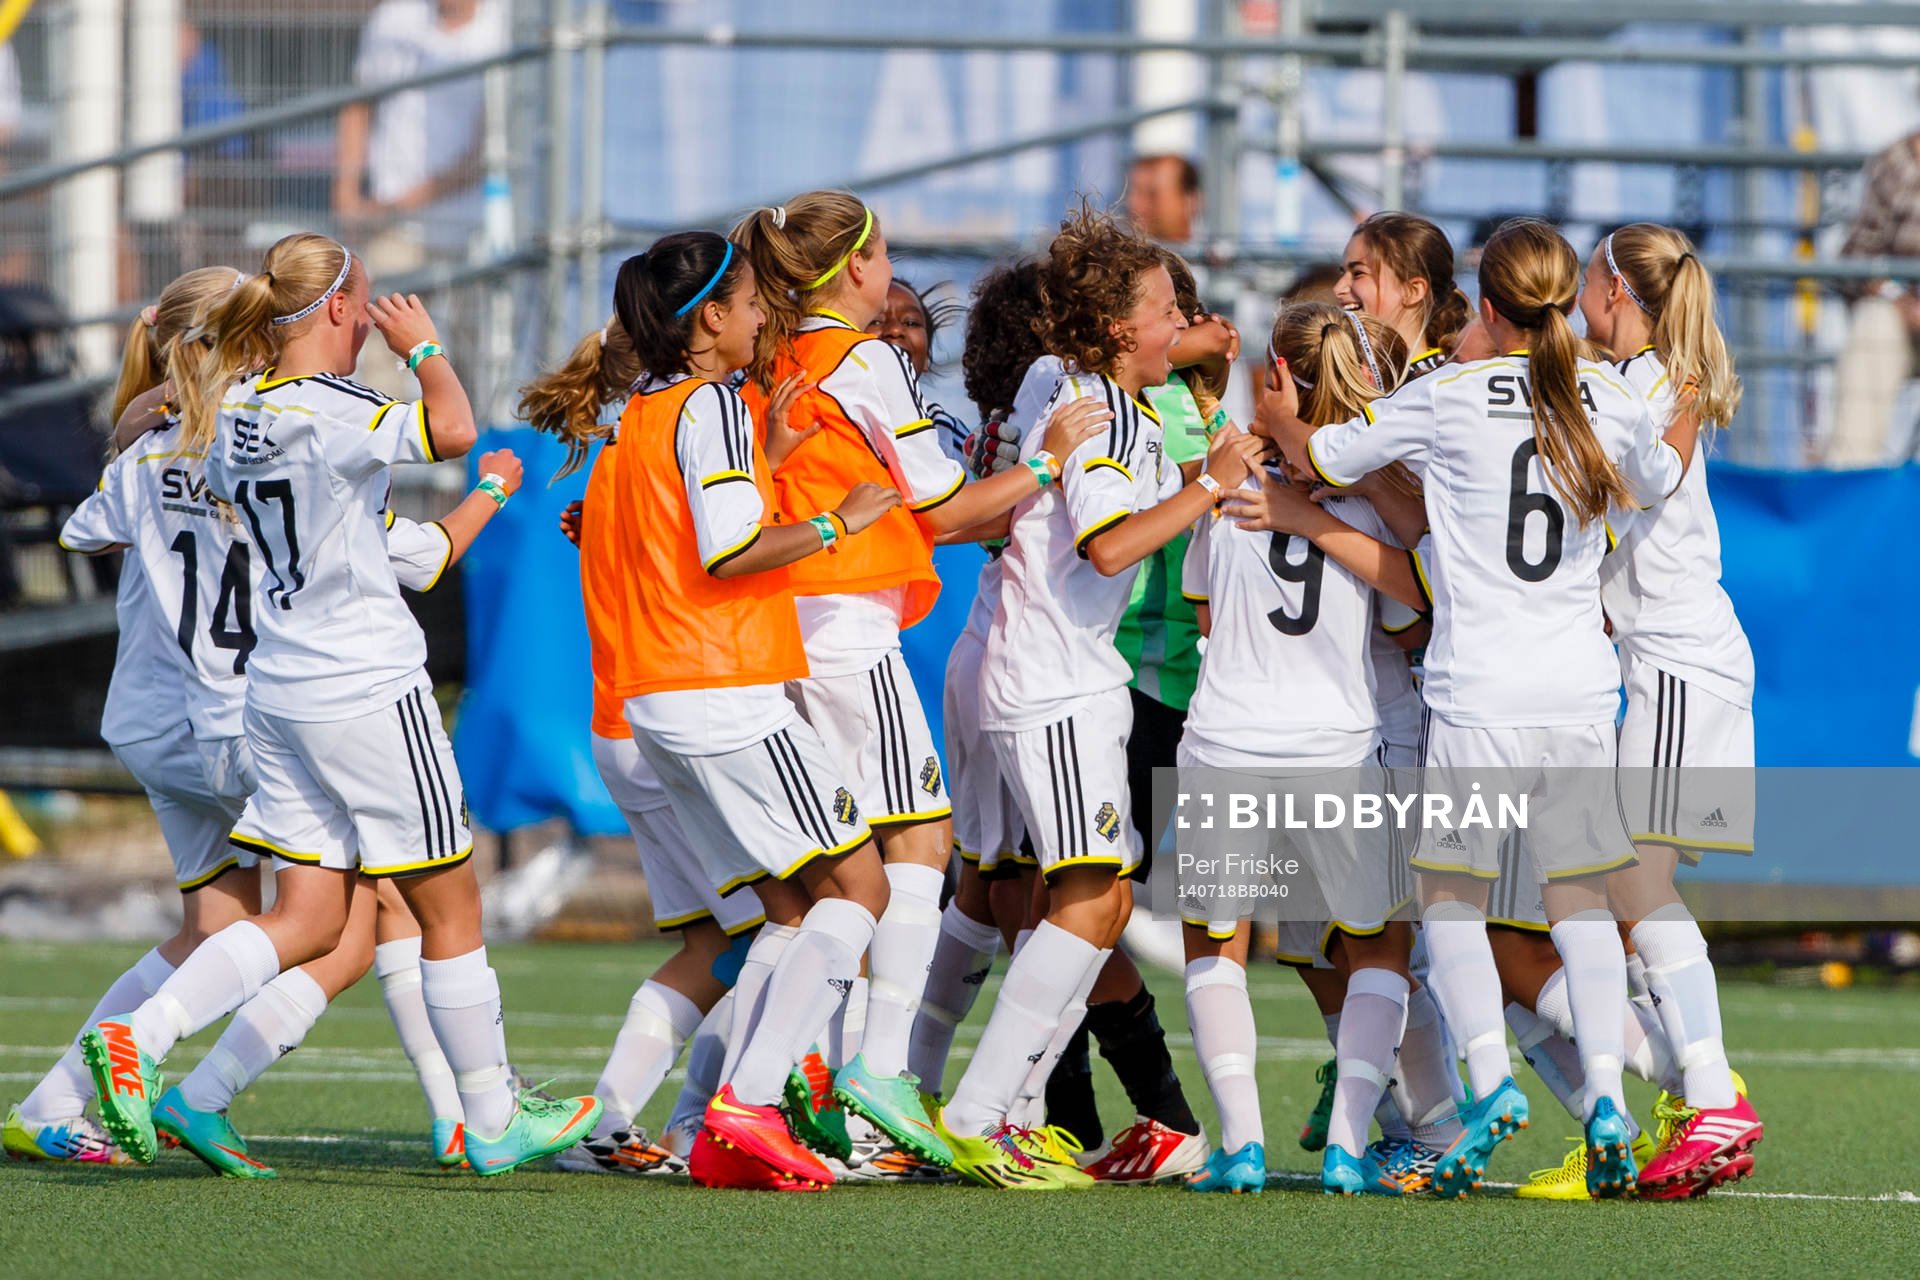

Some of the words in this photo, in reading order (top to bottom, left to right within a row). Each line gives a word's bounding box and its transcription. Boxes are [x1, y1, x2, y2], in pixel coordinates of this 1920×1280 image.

[234, 478, 305, 611] 17
[1505, 436, 1565, 583] 6
[170, 530, 259, 676] 14
[1267, 530, 1326, 637] 9
[1436, 839, 1467, 851] adidas
[97, 1021, 145, 1101] NIKE
[801, 1051, 840, 1115] NIKE
